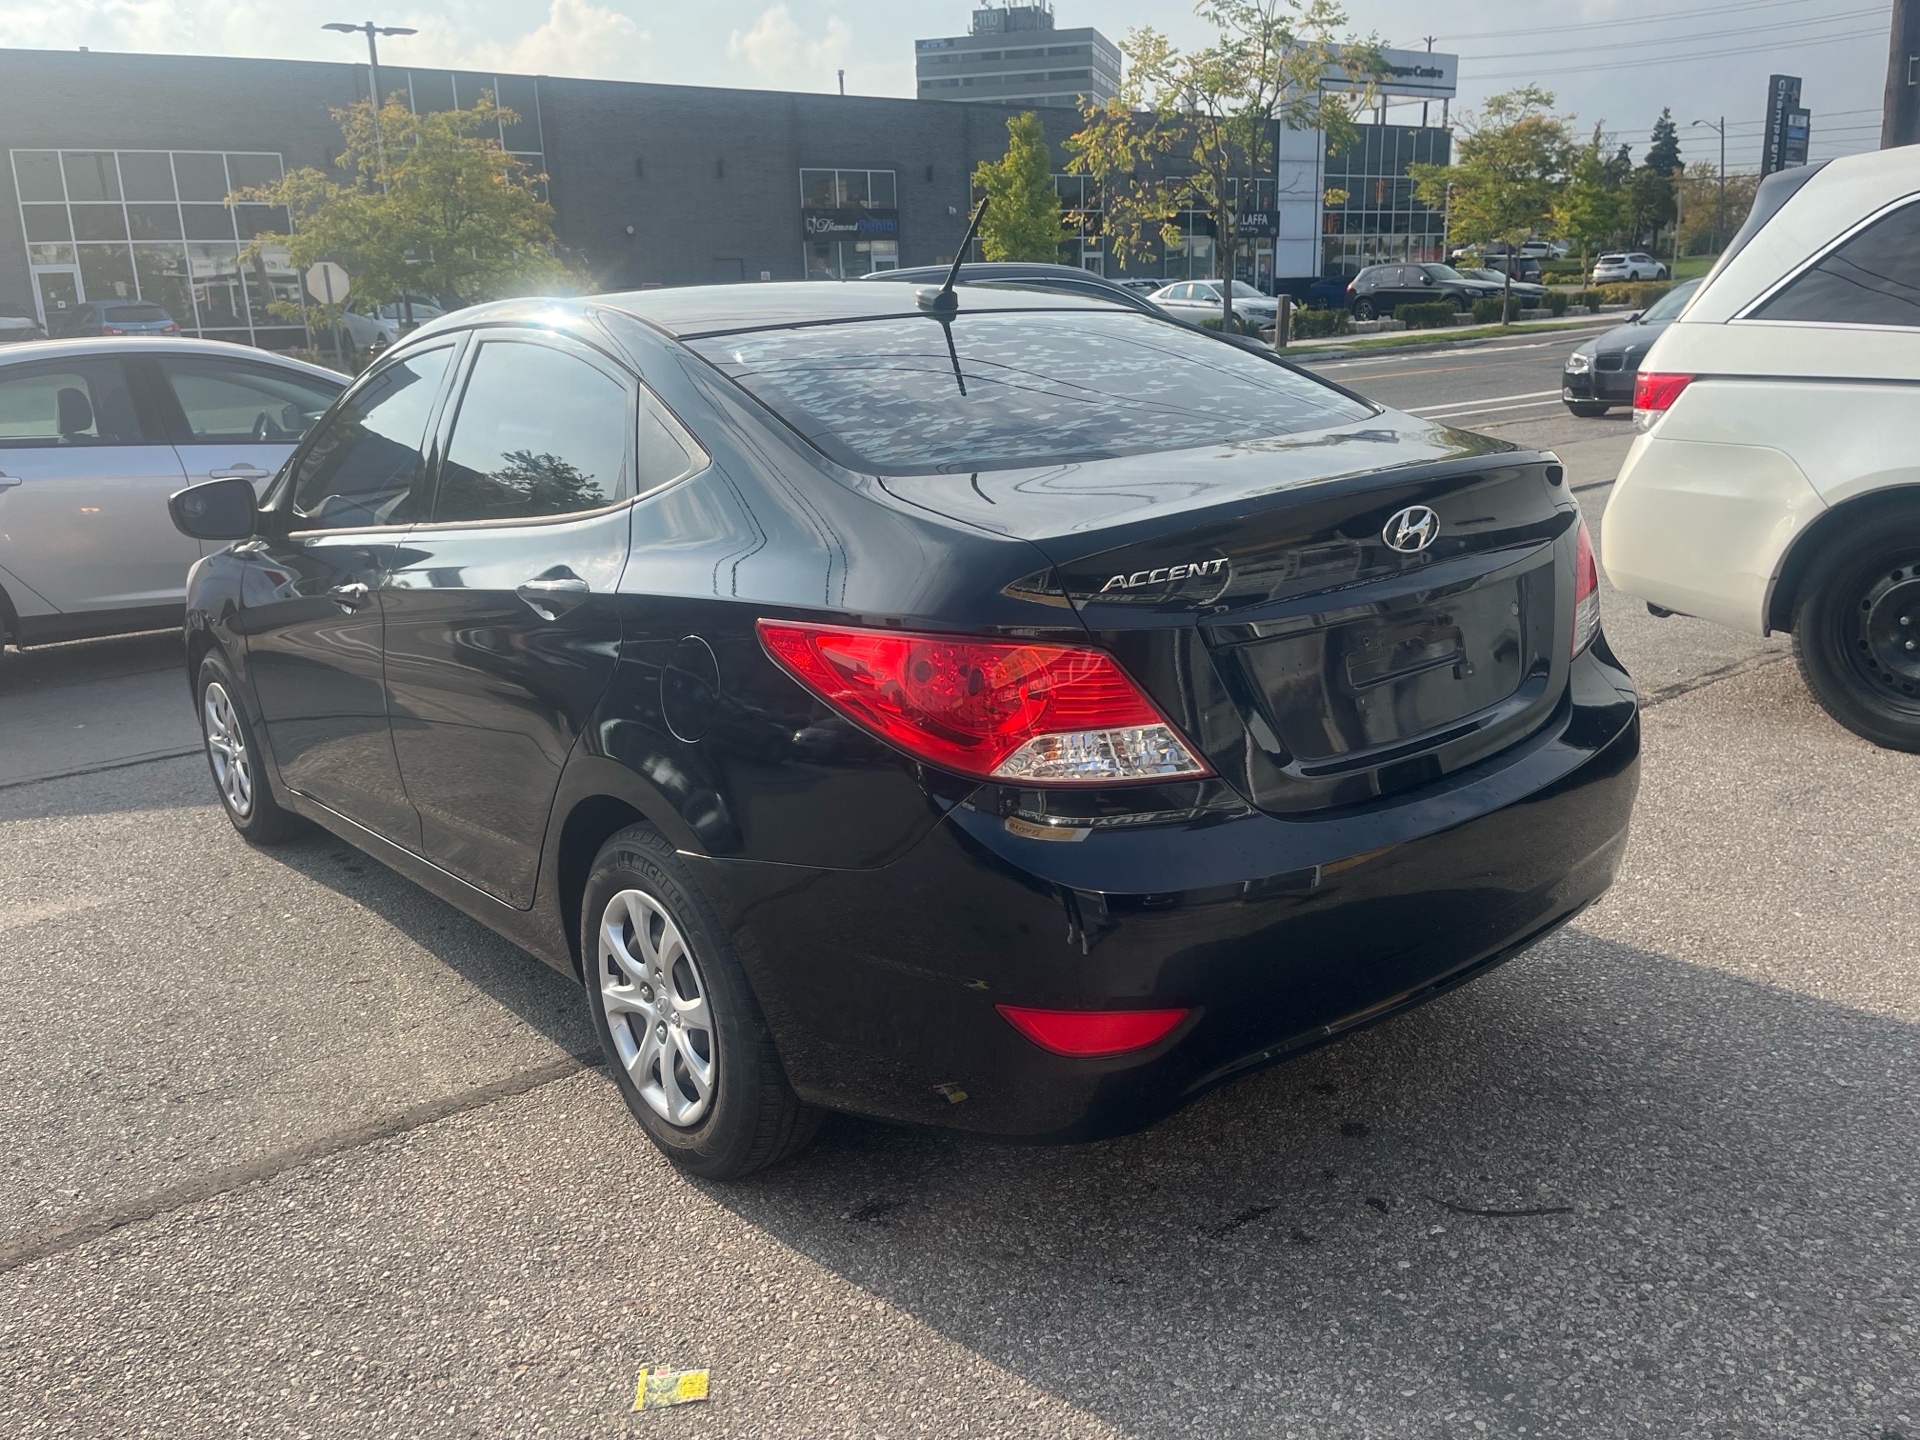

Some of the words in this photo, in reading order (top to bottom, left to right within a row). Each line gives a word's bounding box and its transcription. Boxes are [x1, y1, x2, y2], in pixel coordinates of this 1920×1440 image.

[1770, 79, 1786, 172] Champagne
[816, 217, 858, 232] Diamond
[859, 219, 898, 231] Dental
[1242, 213, 1268, 225] LAFFA
[1100, 557, 1229, 593] ACCENT
[631, 853, 695, 924] MICHELIN
